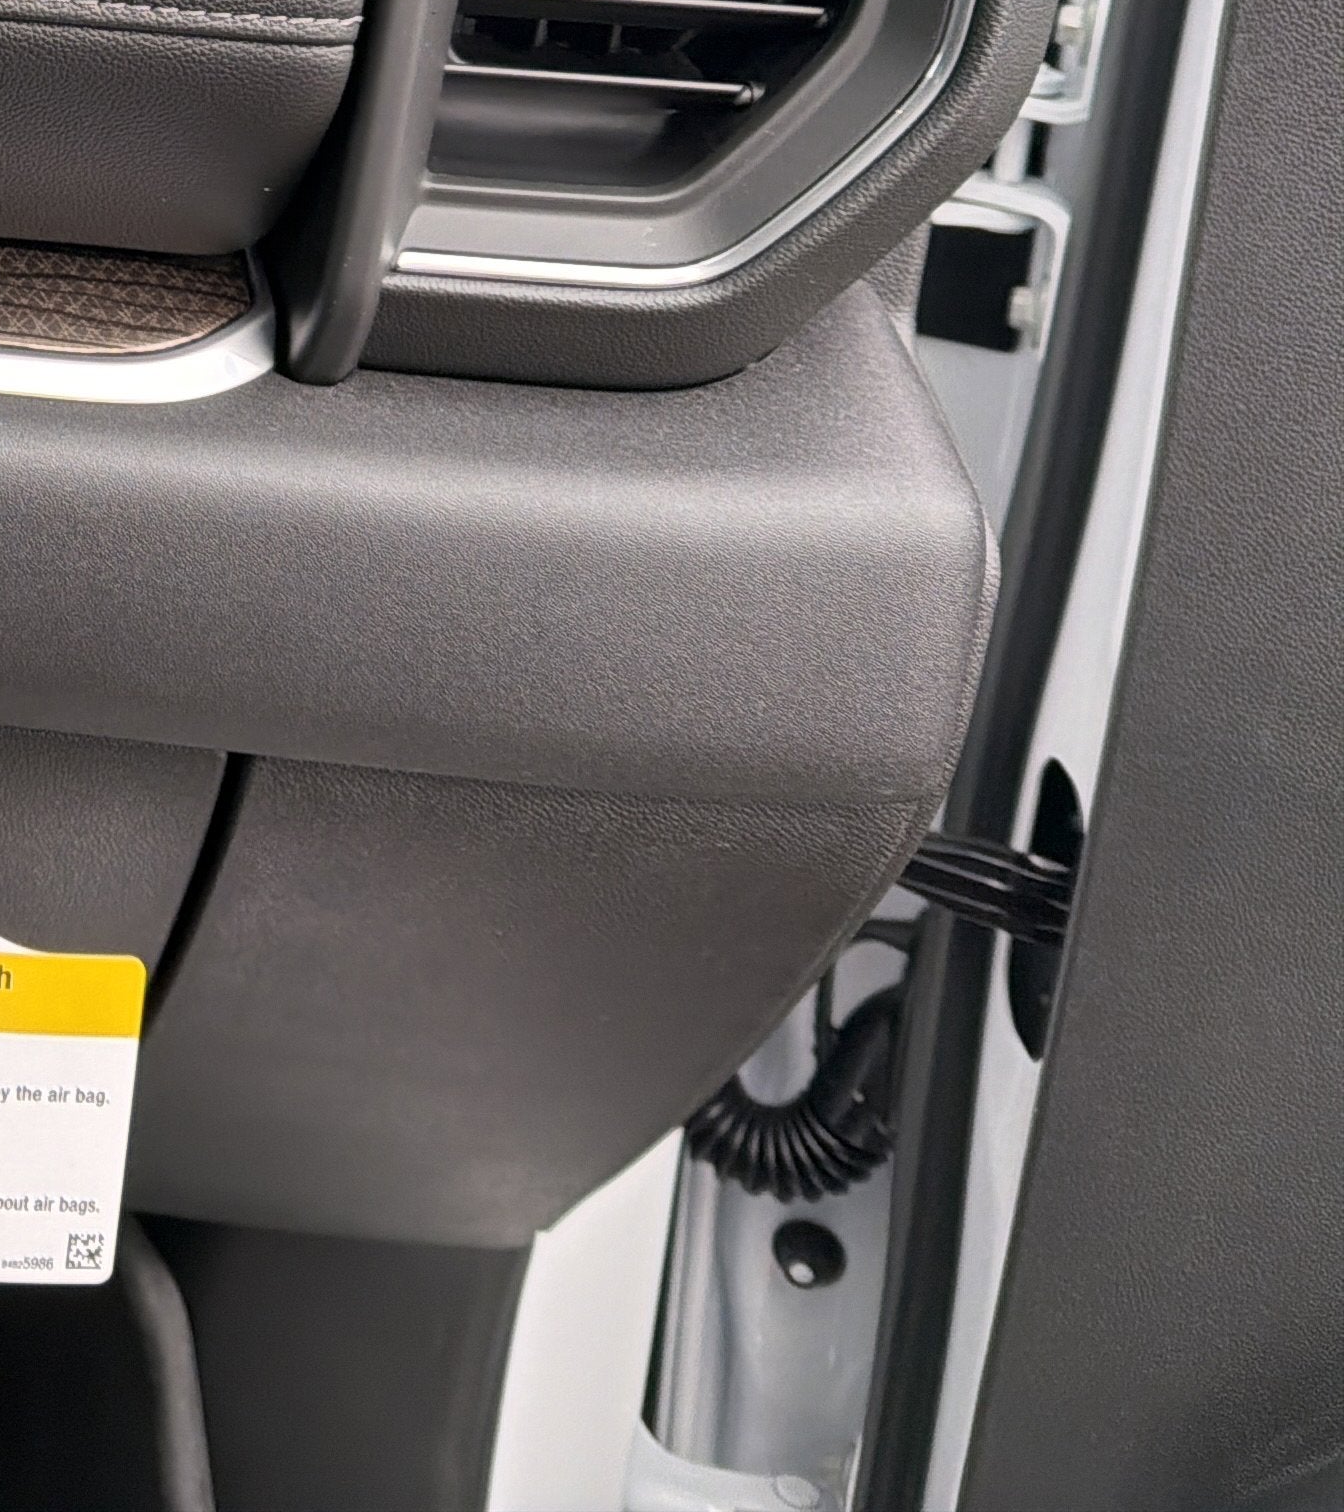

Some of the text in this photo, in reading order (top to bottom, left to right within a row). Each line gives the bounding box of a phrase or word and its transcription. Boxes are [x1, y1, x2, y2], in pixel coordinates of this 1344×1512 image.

[16, 1086, 42, 1101] the
[48, 1087, 70, 1102] air
[76, 1088, 109, 1107] bag.
[34, 1196, 54, 1212] air
[59, 1197, 99, 1215] bags.
